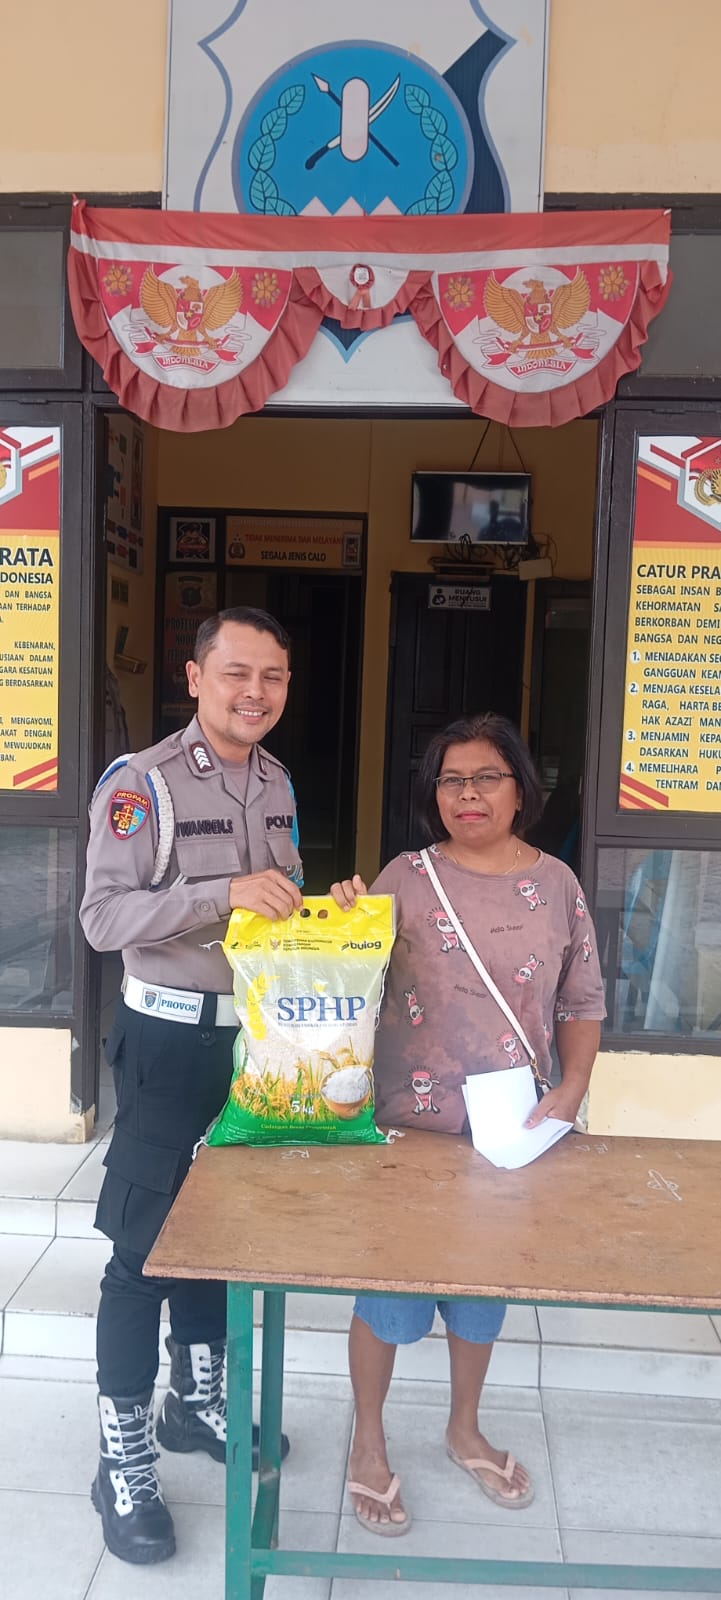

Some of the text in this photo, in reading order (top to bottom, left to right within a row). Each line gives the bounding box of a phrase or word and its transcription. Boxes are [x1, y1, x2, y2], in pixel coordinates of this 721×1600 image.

[162, 356, 209, 369] INDONESIA
[517, 359, 566, 373] INDONESIA
[0, 547, 54, 567] RATA
[260, 551, 327, 562] SEGALA JENIS CALO
[0, 572, 54, 584] DONESIA
[637, 564, 721, 580] CATUR PRA
[5, 590, 52, 599] DAN BANGSA
[636, 584, 676, 595] SEBAGAI
[681, 586, 711, 596] INSAN
[17, 603, 51, 611] TERHADAP
[636, 601, 721, 613] KEHORMATAN S
[635, 617, 720, 628] BERKORBAN DEMI
[634, 633, 721, 645] BANGSA DAN NEG
[15, 641, 56, 651] KEBENARAN,
[30, 654, 54, 663] DALAM
[632, 651, 721, 663] 1. MENIADAKAN SE
[19, 667, 53, 675] KESATUAN
[643, 667, 697, 680] GANGGUAN
[6, 679, 54, 688] BERDASARKAN
[630, 683, 720, 696] 2. MENJAGA KESELA
[642, 699, 669, 711] RAGA,
[679, 701, 709, 711] HARTA
[11, 716, 54, 726] MENGAYOMI,
[641, 715, 721, 728] HAK AZAZI MAN
[25, 729, 52, 738] DENGAN
[627, 730, 721, 744] 3. MENJAMIN KEPA
[4, 741, 52, 750] MEWUJUDKAN
[640, 747, 689, 758] DASARKAN
[626, 762, 635, 772] 4.
[639, 763, 699, 774] MEMELIHARA
[656, 779, 698, 790] TENTRAM
[116, 791, 148, 806] PROPAM
[350, 940, 382, 951] bulog
[161, 999, 197, 1012] PROVOS
[277, 996, 366, 1022] SPHP
[291, 1100, 315, 1115] 5 kg
